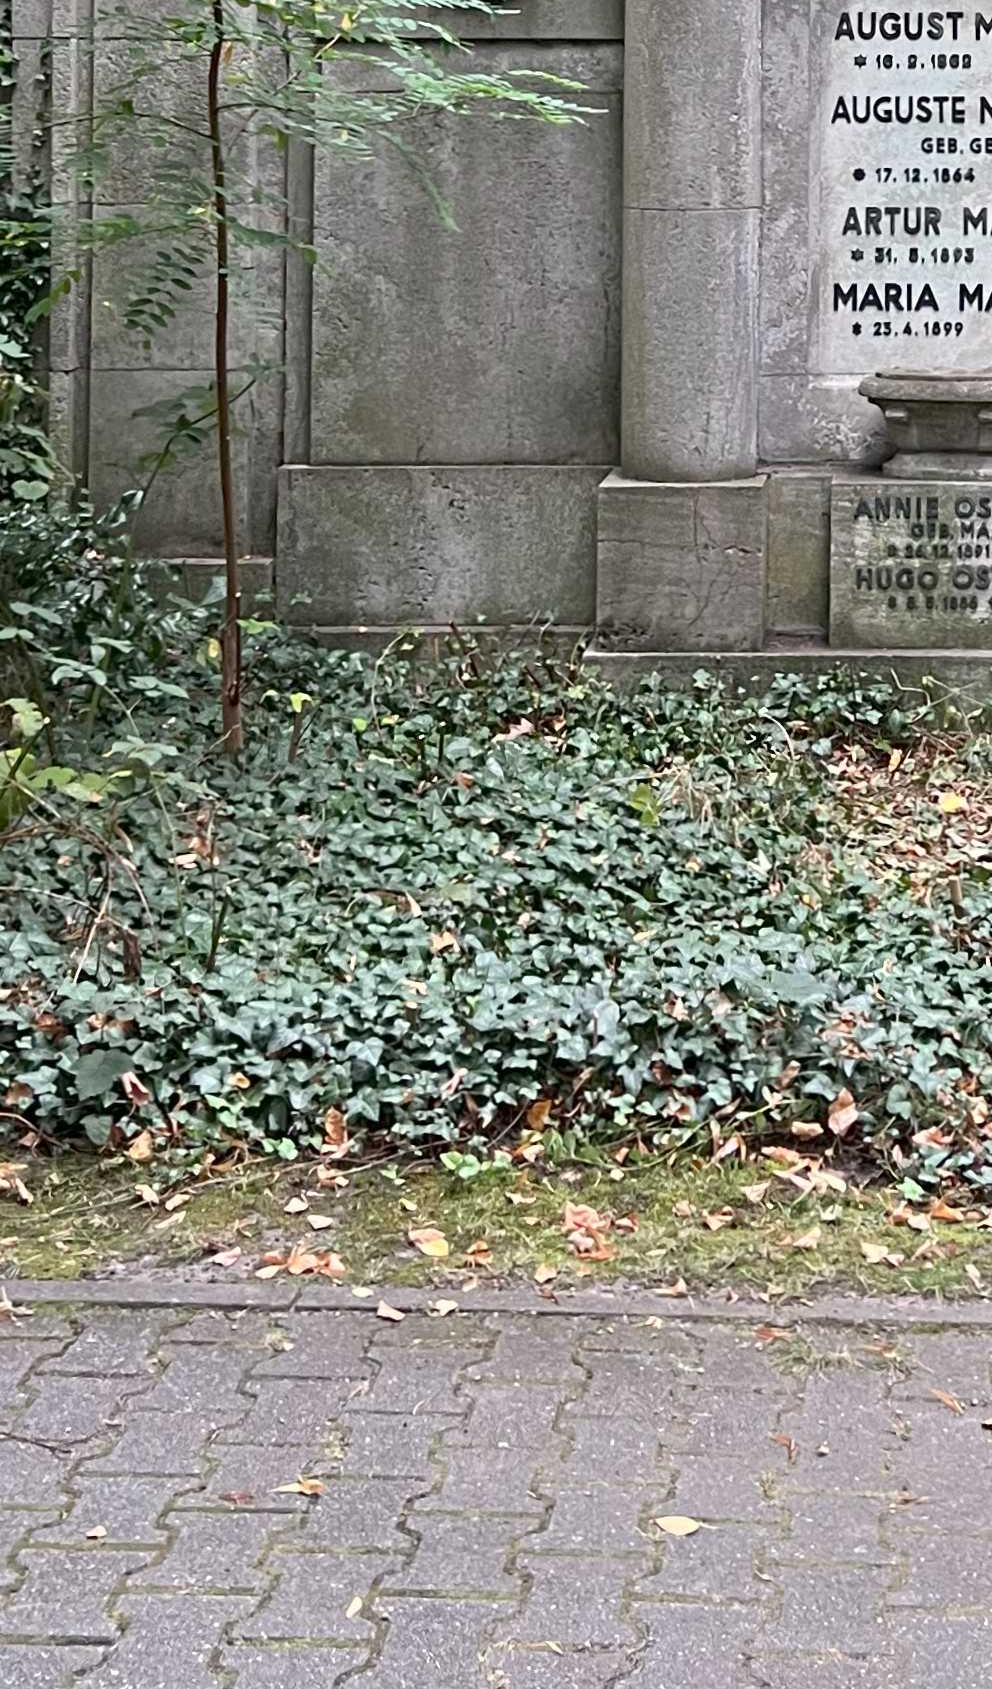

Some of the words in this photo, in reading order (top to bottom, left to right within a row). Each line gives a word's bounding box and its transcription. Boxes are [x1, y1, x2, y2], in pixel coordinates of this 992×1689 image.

[834, 11, 964, 41] AUGUST
[831, 95, 966, 124] AUGUSTE
[921, 137, 963, 155] GEB.
[842, 206, 941, 236] ARTUR
[833, 282, 939, 312] MARIA
[854, 496, 939, 521] ANNIE
[911, 523, 954, 540] GEB.
[855, 567, 939, 591] HUGO
